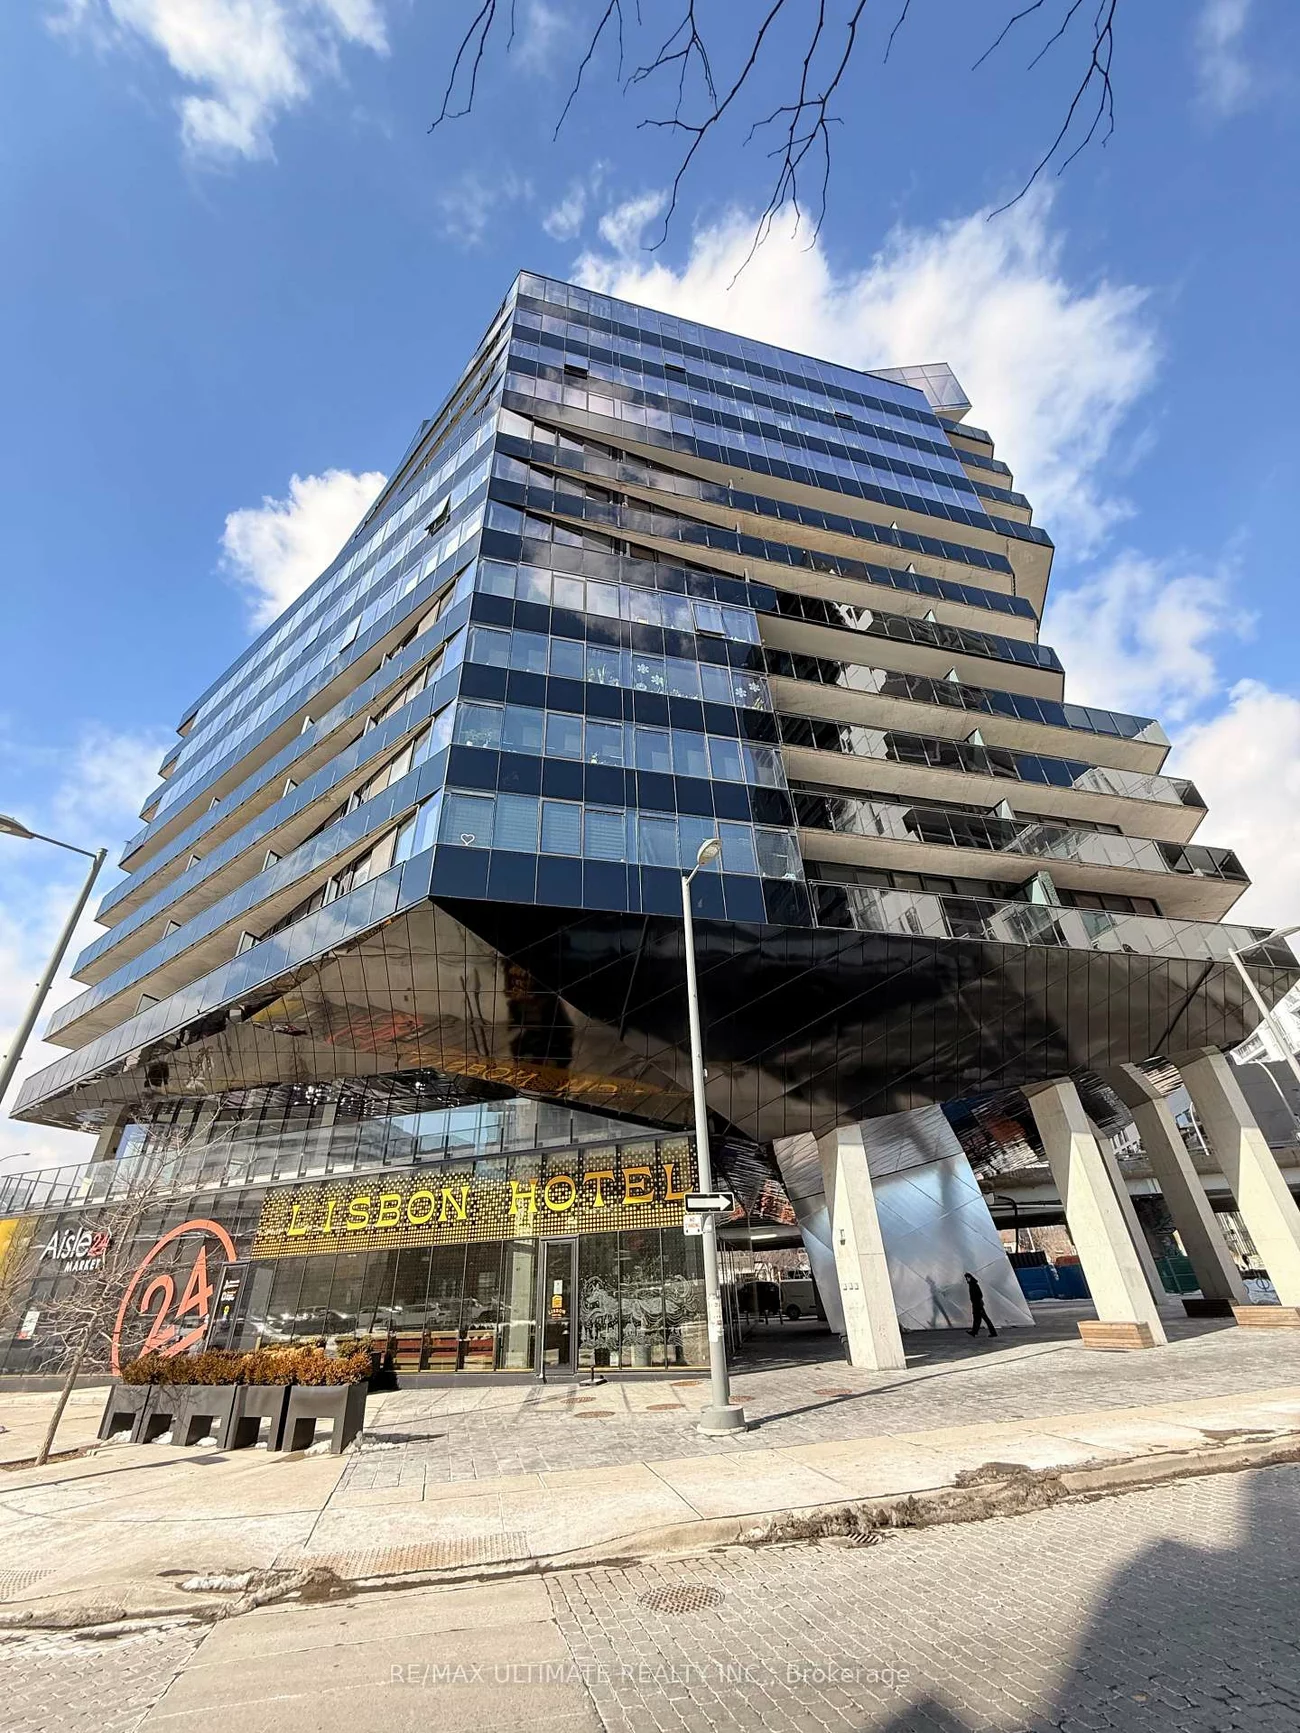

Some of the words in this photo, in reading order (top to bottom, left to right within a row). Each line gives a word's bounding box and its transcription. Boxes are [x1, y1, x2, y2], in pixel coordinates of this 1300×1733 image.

[287, 1186, 471, 1236] LISBON
[508, 1163, 694, 1215] HOTEL
[63, 1258, 102, 1272] MARKET
[138, 1245, 214, 1359] 24
